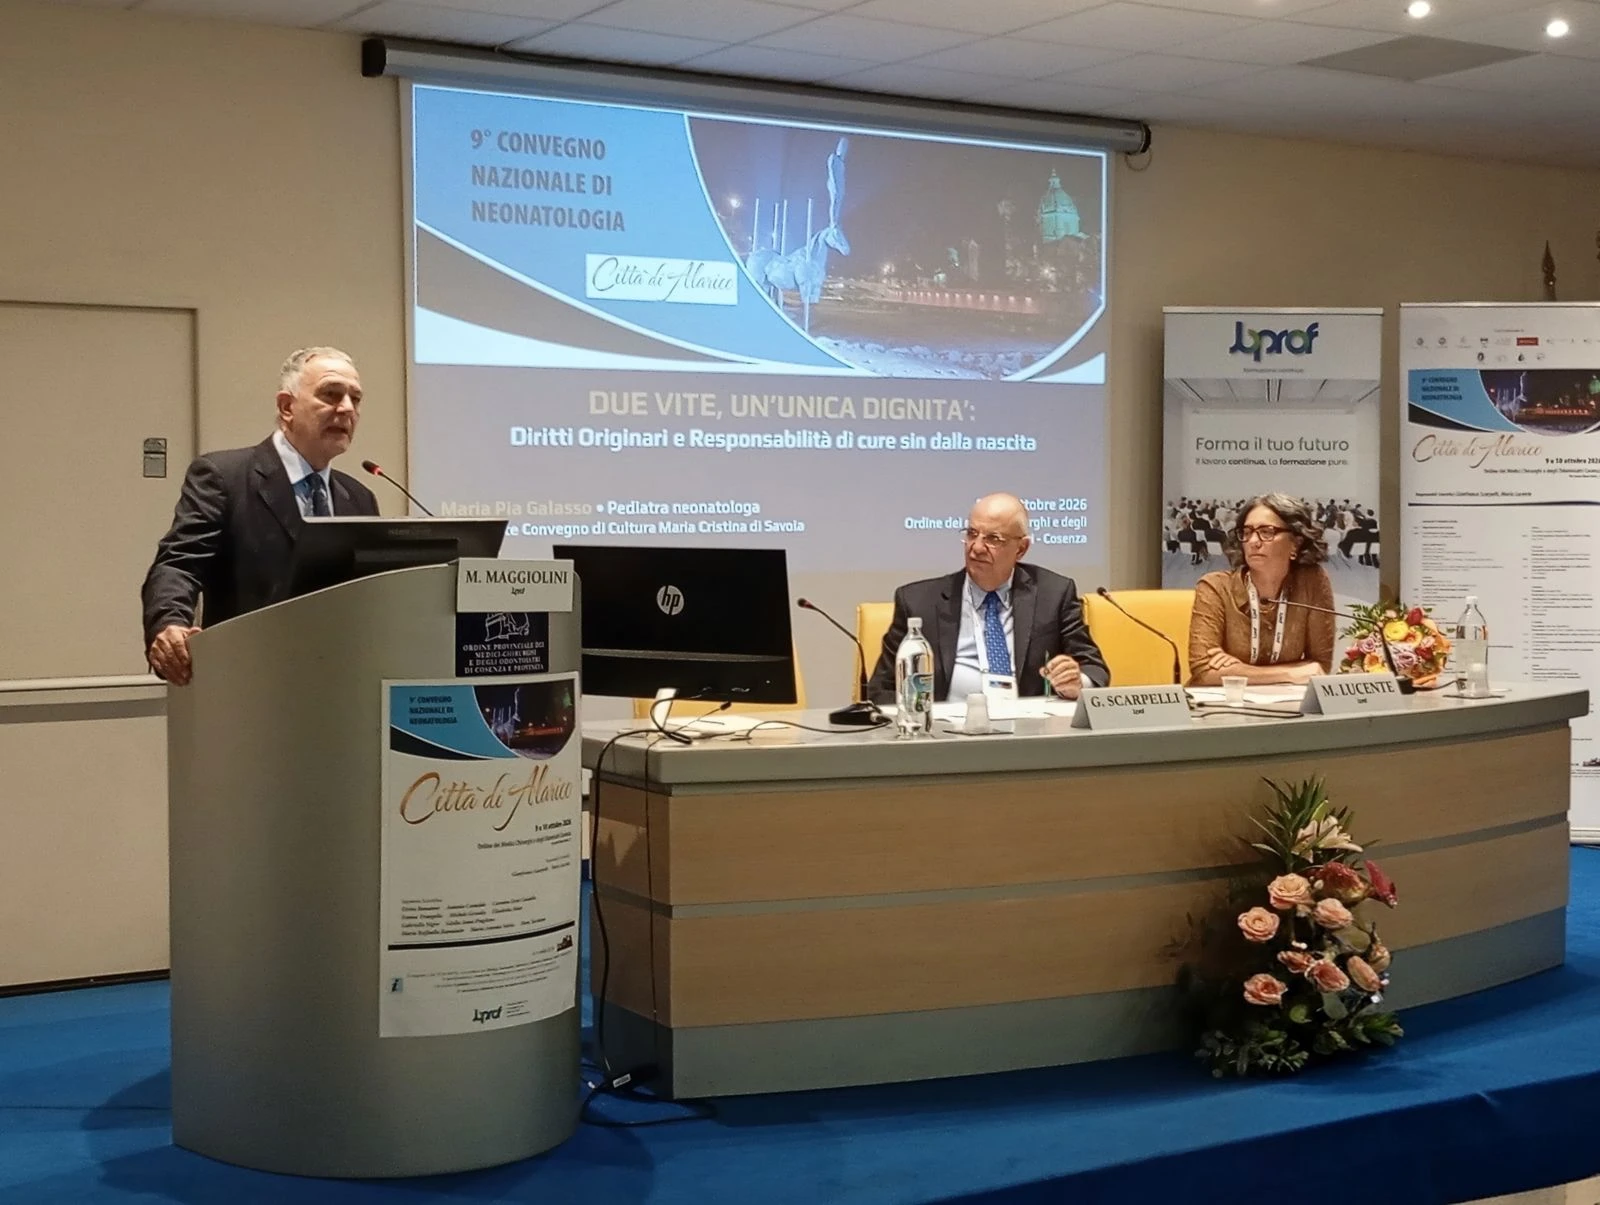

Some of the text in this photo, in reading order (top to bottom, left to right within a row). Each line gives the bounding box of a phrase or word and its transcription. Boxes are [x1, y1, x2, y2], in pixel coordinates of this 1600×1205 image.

[470, 129, 606, 160] 9° CONVEGNO
[472, 165, 612, 195] NAZIONALE DI
[472, 200, 625, 232] NEONATOLOGIA
[592, 257, 734, 301] Città di Alarico
[588, 390, 648, 415] DUE
[654, 391, 723, 420] VITE,
[510, 426, 1037, 452] Diritti Originari e Responsabilità di cure sin dalla nascita
[1195, 436, 1349, 451] Forma il tuo futuro
[1279, 457, 1327, 466] formazione
[441, 500, 761, 517] Maria Pia Galasso Pediatra neonatologa
[1059, 498, 1088, 511] 2026
[522, 522, 589, 538] Convegno
[592, 521, 605, 535] di
[607, 520, 656, 534] Cultura
[658, 520, 696, 533] Maria
[698, 519, 747, 533] Cristina
[749, 519, 762, 532] di
[764, 519, 805, 532] Savoia
[904, 517, 943, 530] Ordine
[945, 516, 962, 529] dei
[1052, 517, 1061, 529] e
[1063, 515, 1088, 531] degli
[1043, 533, 1088, 545] Cosenza
[466, 570, 568, 584] M. MAGGIOLINI
[658, 585, 683, 615] hp
[1321, 681, 1395, 697] M. LUCENTE
[1091, 692, 1181, 708] G. SCARPELLI
[400, 764, 572, 831] Città di Alarico
